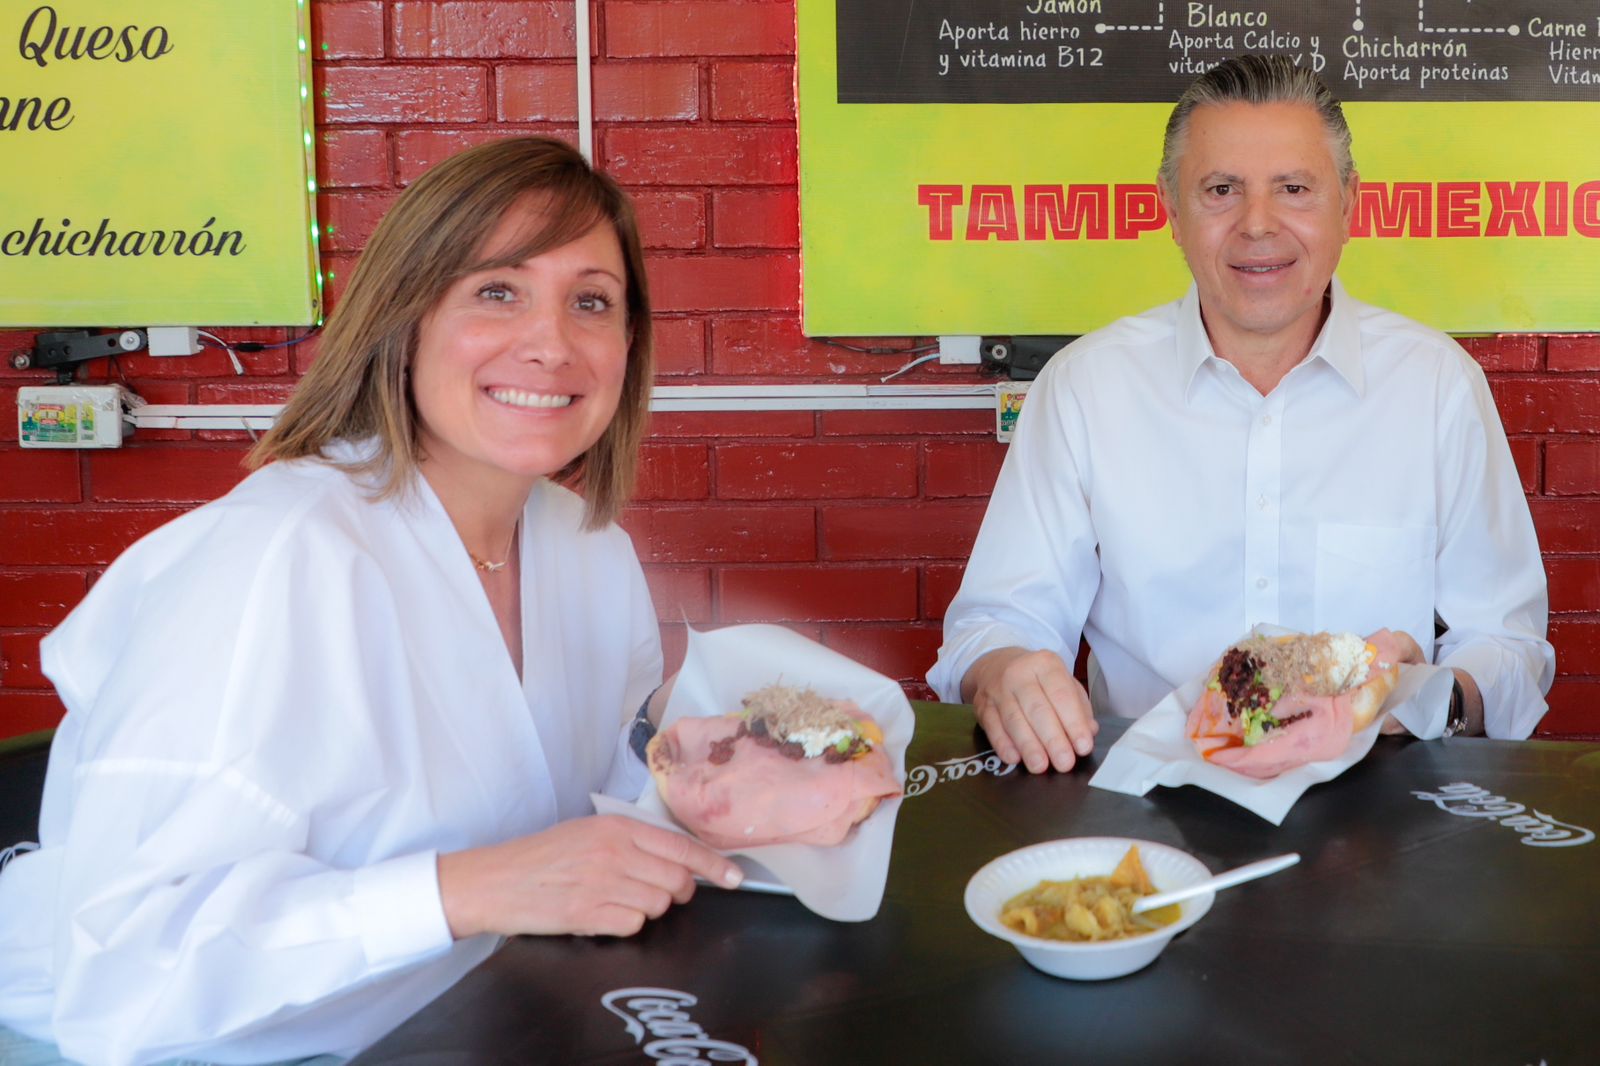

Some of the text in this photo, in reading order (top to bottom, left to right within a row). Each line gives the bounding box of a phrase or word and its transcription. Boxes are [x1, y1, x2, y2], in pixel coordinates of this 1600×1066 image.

[1187, 2, 1268, 28] Blanco
[1527, 17, 1587, 38] Carne
[19, 5, 175, 67] Queso
[938, 19, 1080, 49] Aporta hierro
[1168, 29, 1320, 57] Aporta Calcio y
[1342, 34, 1468, 58] Chicharrón
[938, 46, 1104, 75] y vitamina B12
[1343, 60, 1509, 89] Aporta proteinas
[917, 183, 1176, 241] TAMP
[1, 216, 247, 257] chicharrón
